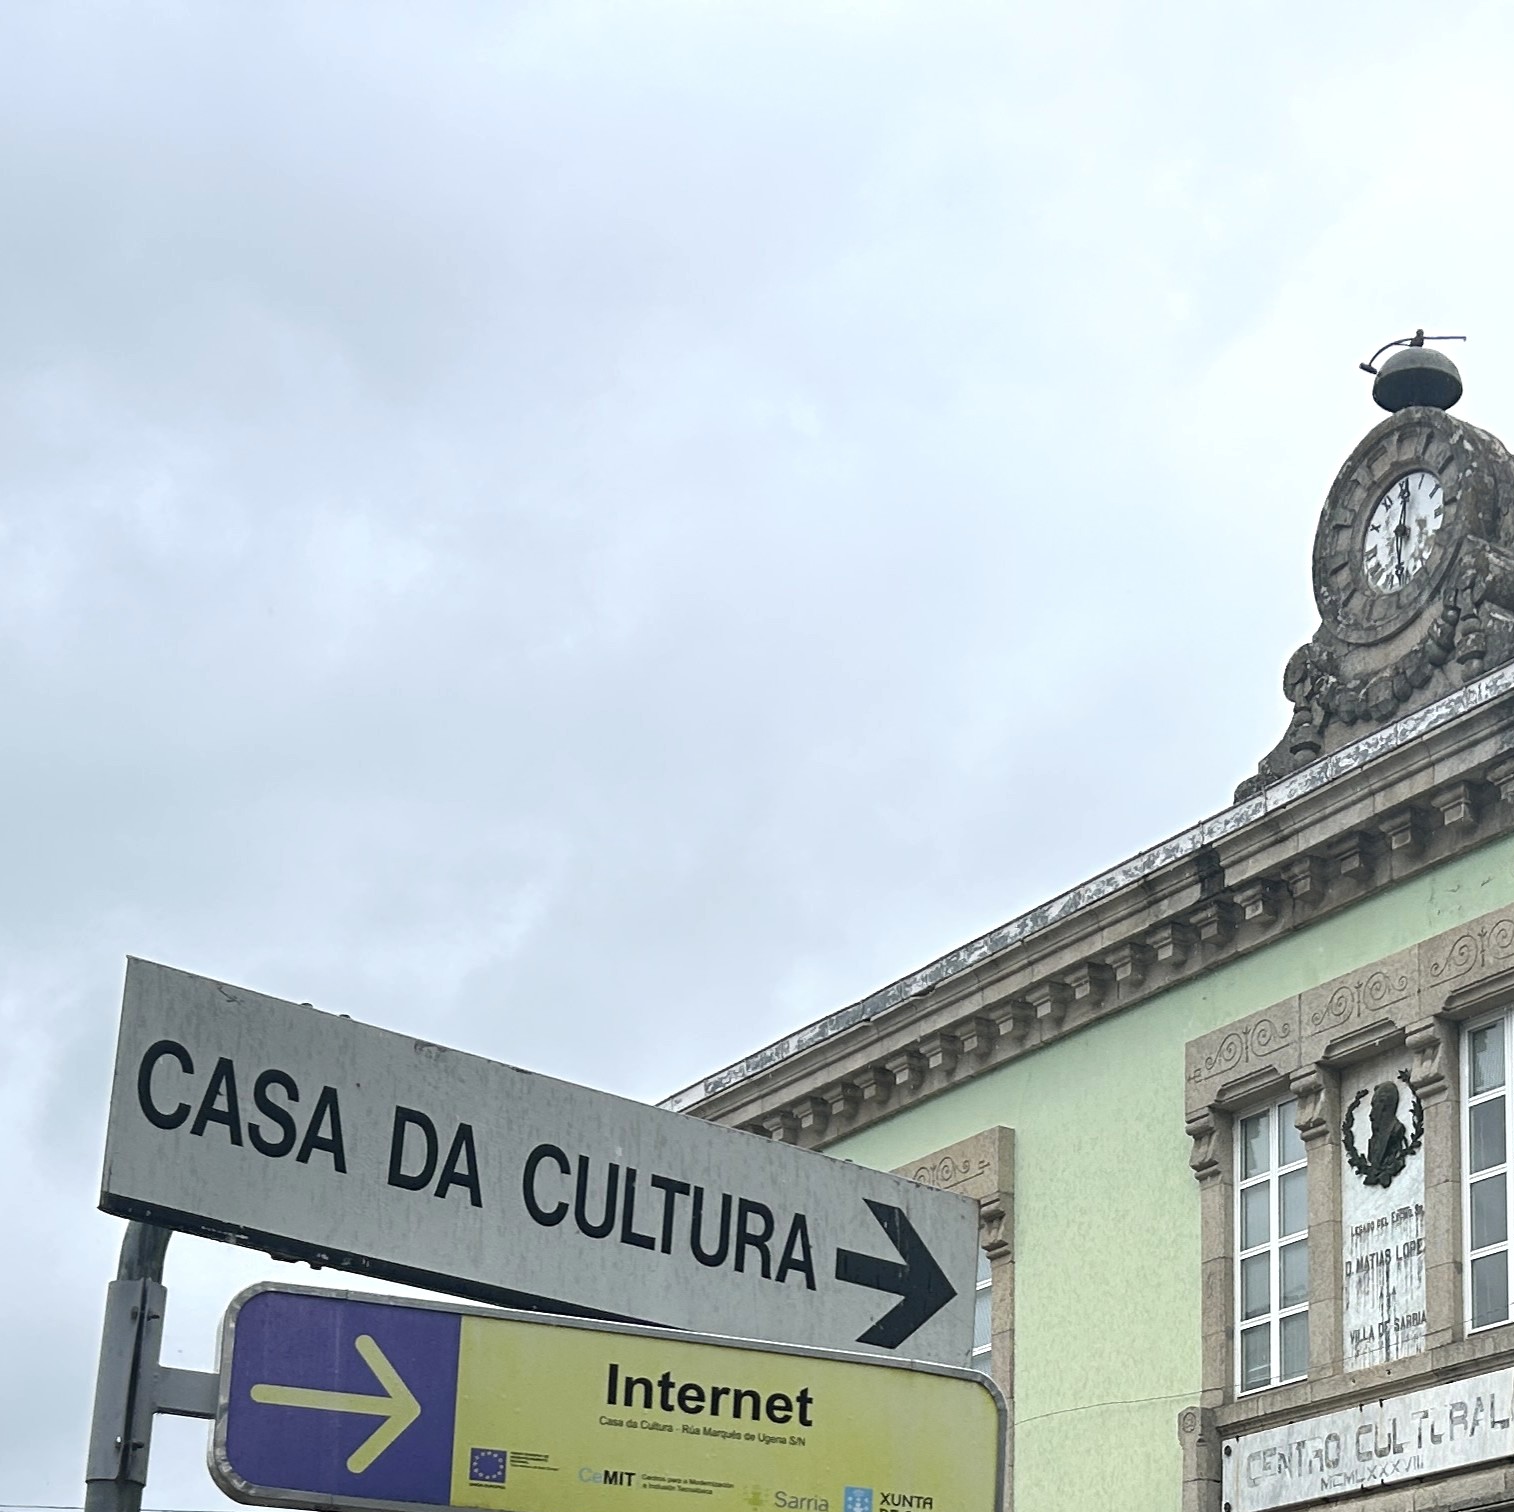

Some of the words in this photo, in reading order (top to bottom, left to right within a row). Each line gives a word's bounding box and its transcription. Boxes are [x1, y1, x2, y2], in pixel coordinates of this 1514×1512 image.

[138, 1039, 347, 1174] CASA
[387, 1105, 483, 1208] DA
[523, 1143, 817, 1291] CULTURA
[1356, 1249, 1391, 1273] MATIAS
[1396, 1237, 1426, 1260] LOPE
[1350, 1325, 1375, 1344] VILLA
[1378, 1321, 1390, 1338] DE
[1394, 1310, 1427, 1332] SARRIA
[607, 1363, 813, 1427] Internet
[599, 1415, 624, 1427] Casa
[625, 1419, 638, 1429] da
[640, 1420, 673, 1432] Cultura
[682, 1423, 701, 1435] Rúa
[744, 1432, 756, 1441] de
[1246, 1432, 1341, 1488] CENTRO
[1355, 1393, 1510, 1462] CULTURAL
[578, 1466, 636, 1487] CeMIT
[774, 1491, 829, 1512] Sarria
[879, 1492, 934, 1510] XUNTA
